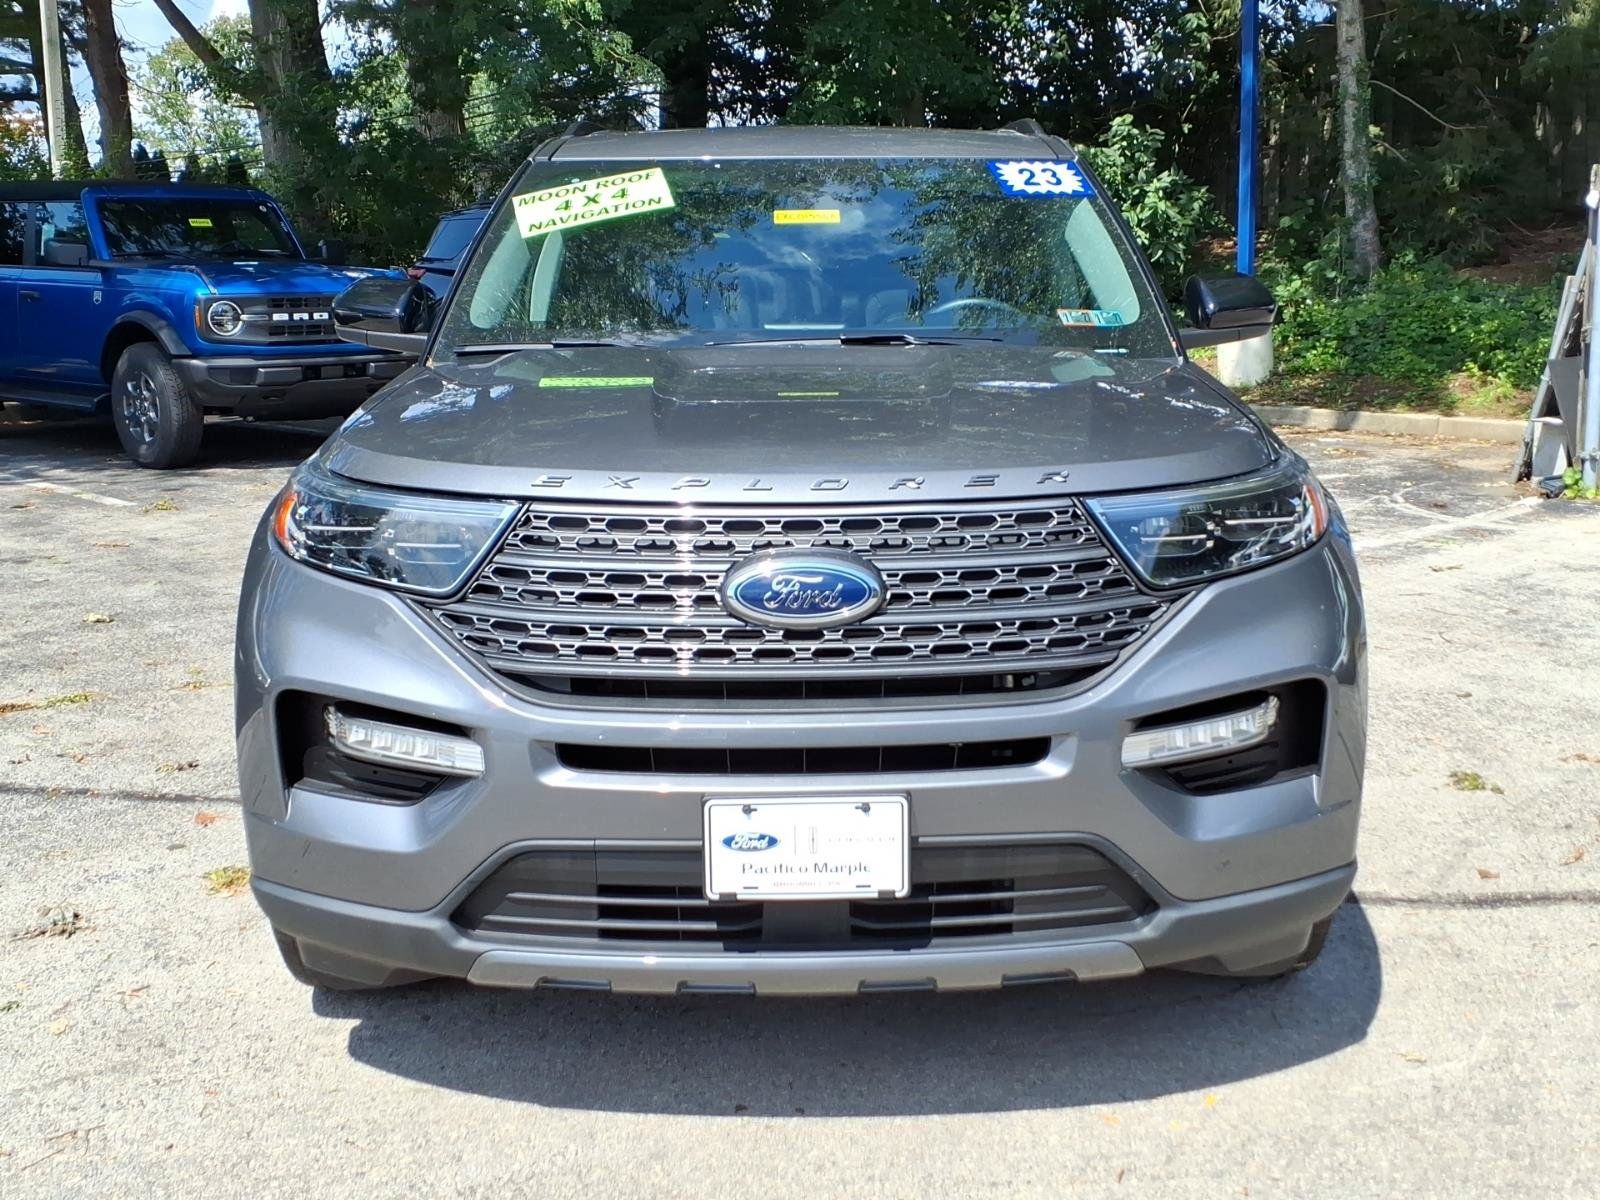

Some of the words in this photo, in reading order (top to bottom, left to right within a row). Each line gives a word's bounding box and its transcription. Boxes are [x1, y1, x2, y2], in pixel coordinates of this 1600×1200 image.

[1018, 168, 1062, 186] 23
[518, 184, 587, 207] MOON
[595, 171, 657, 190] ROOF
[554, 199, 573, 212] 4
[582, 193, 600, 207] X
[611, 187, 630, 200] 4
[528, 196, 662, 232] NAVIGATION
[531, 470, 1070, 491] EXPLORER
[763, 574, 844, 609] Ford
[731, 832, 769, 850] Ford
[741, 862, 809, 875] Pacifico
[813, 861, 872, 876] Marple
